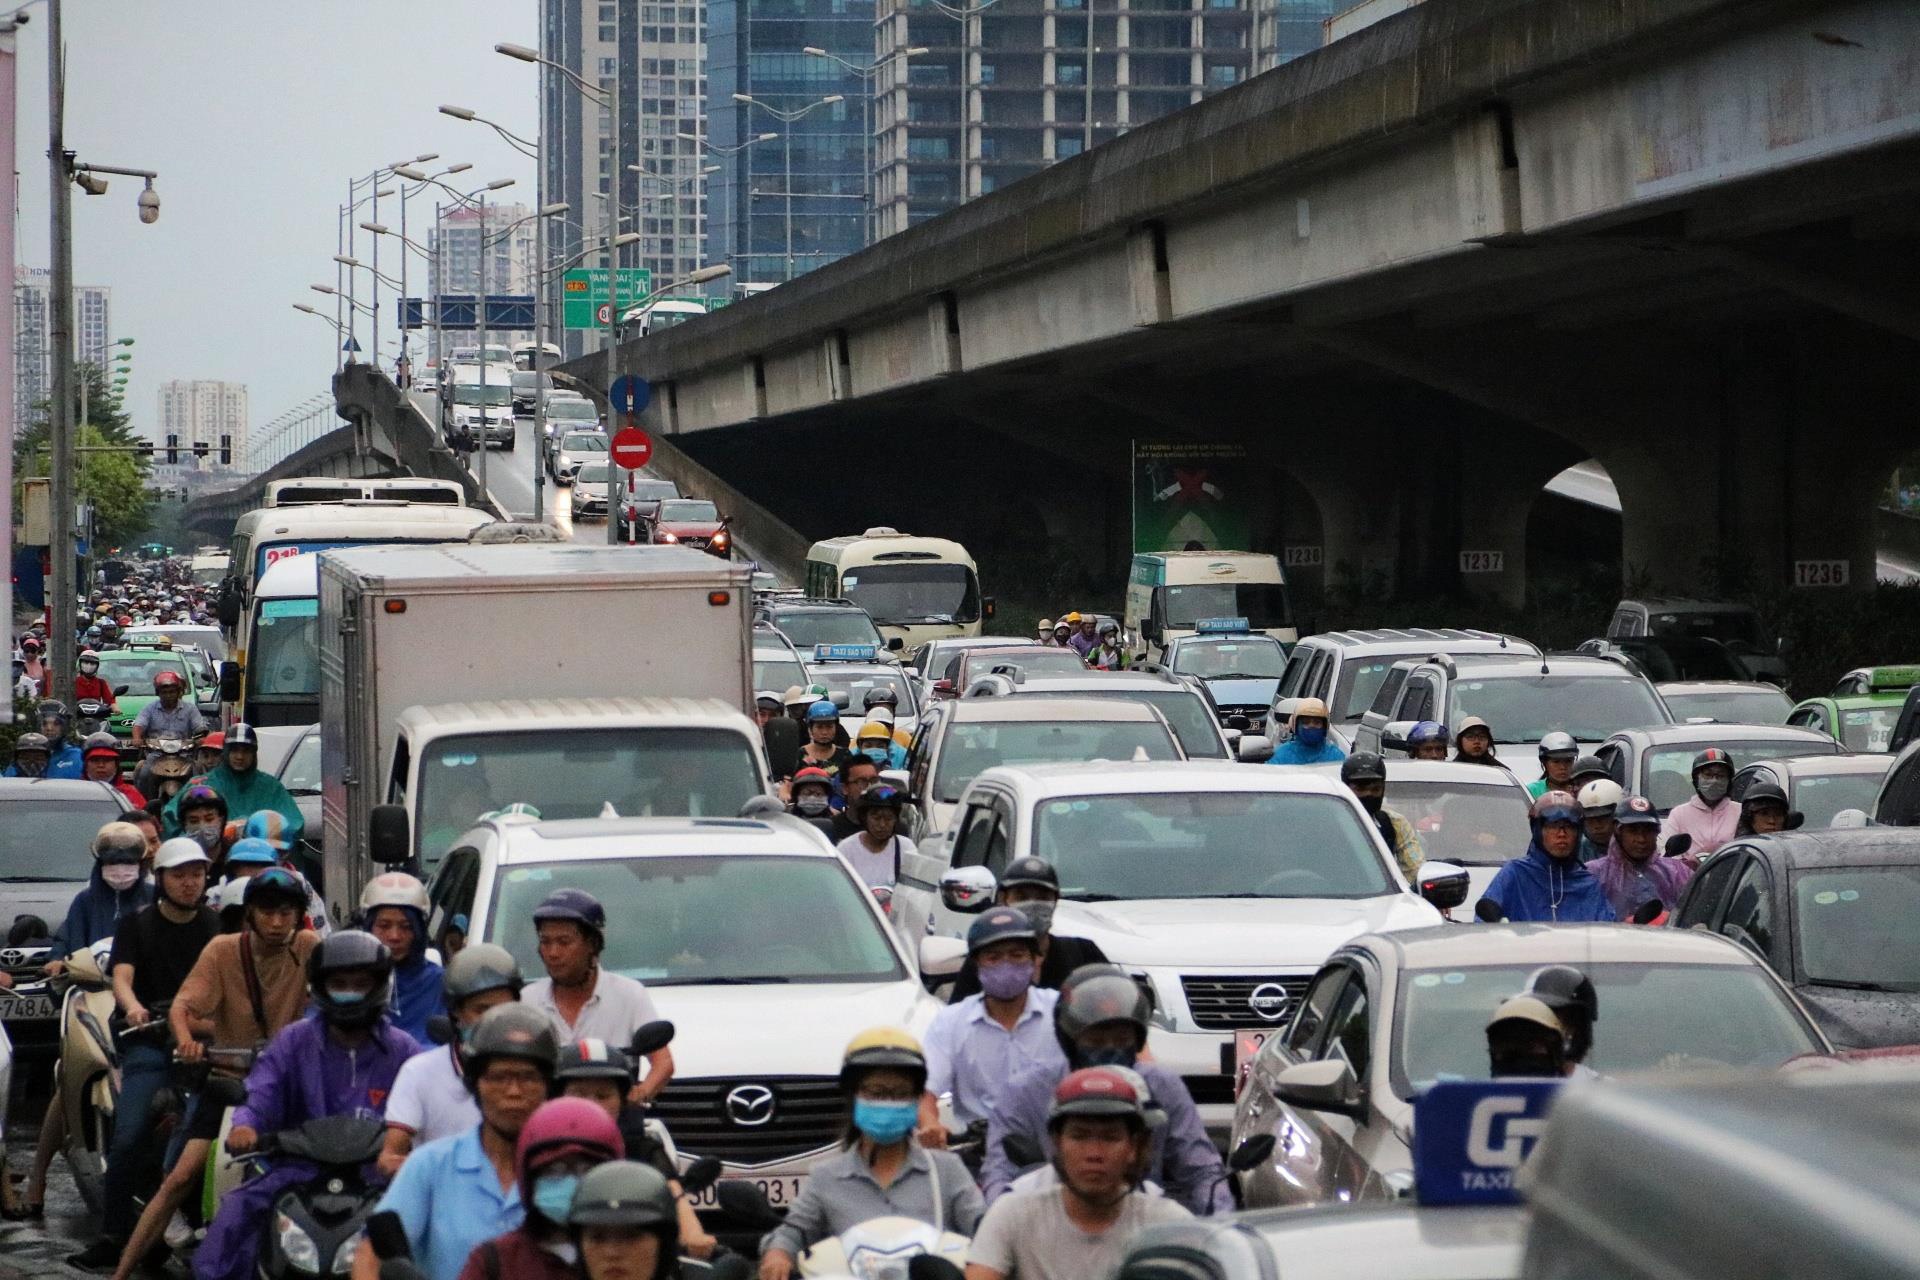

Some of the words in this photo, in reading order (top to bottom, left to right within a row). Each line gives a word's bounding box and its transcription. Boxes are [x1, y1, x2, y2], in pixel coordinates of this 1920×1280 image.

[1463, 552, 1500, 570] T237
[1798, 563, 1842, 584] T236
[833, 648, 847, 656] TAXI
[847, 648, 859, 657] SAO
[4, 999, 57, 1017] 748.4
[1253, 998, 1285, 1008] NISSA
[1462, 1172, 1512, 1190] TAXI
